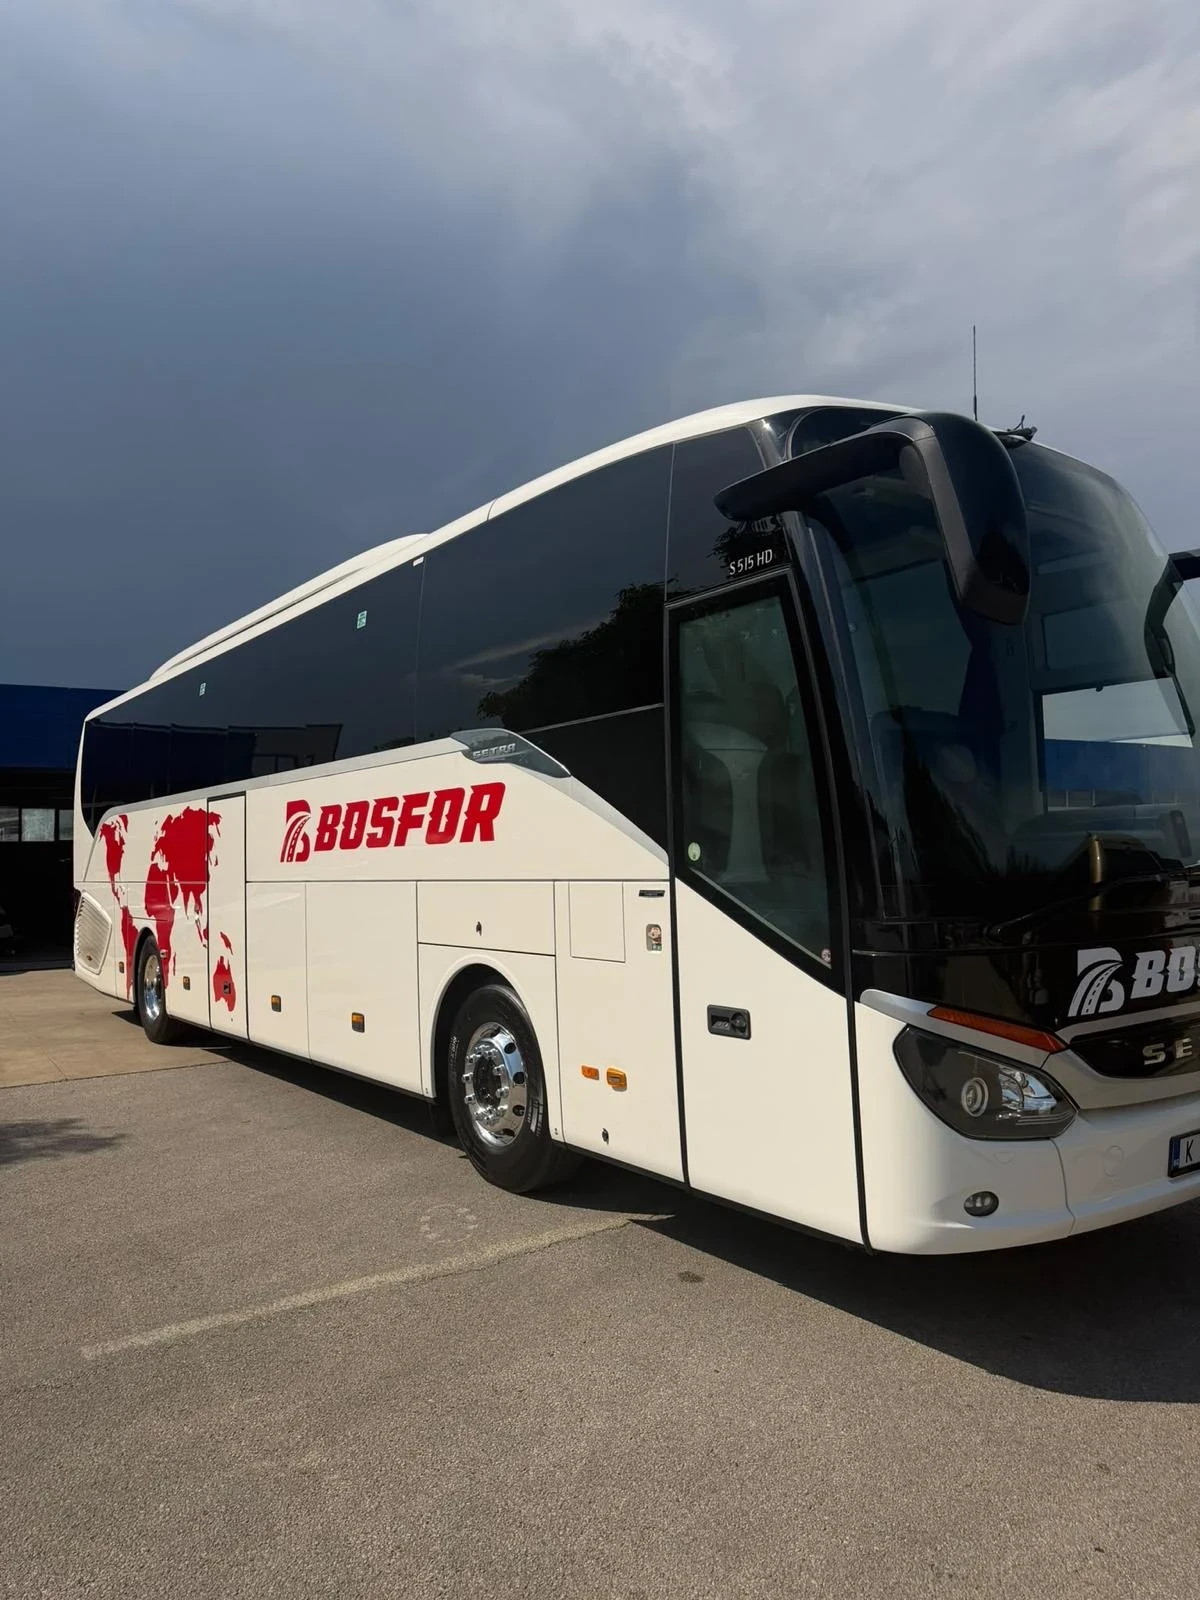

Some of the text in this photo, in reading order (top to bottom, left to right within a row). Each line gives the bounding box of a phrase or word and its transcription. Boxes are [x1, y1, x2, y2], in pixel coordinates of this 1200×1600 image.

[729, 549, 773, 575] S 515 HD
[472, 743, 516, 758] SETRA
[314, 782, 506, 851] BOSFOR
[1130, 946, 1200, 999] BO
